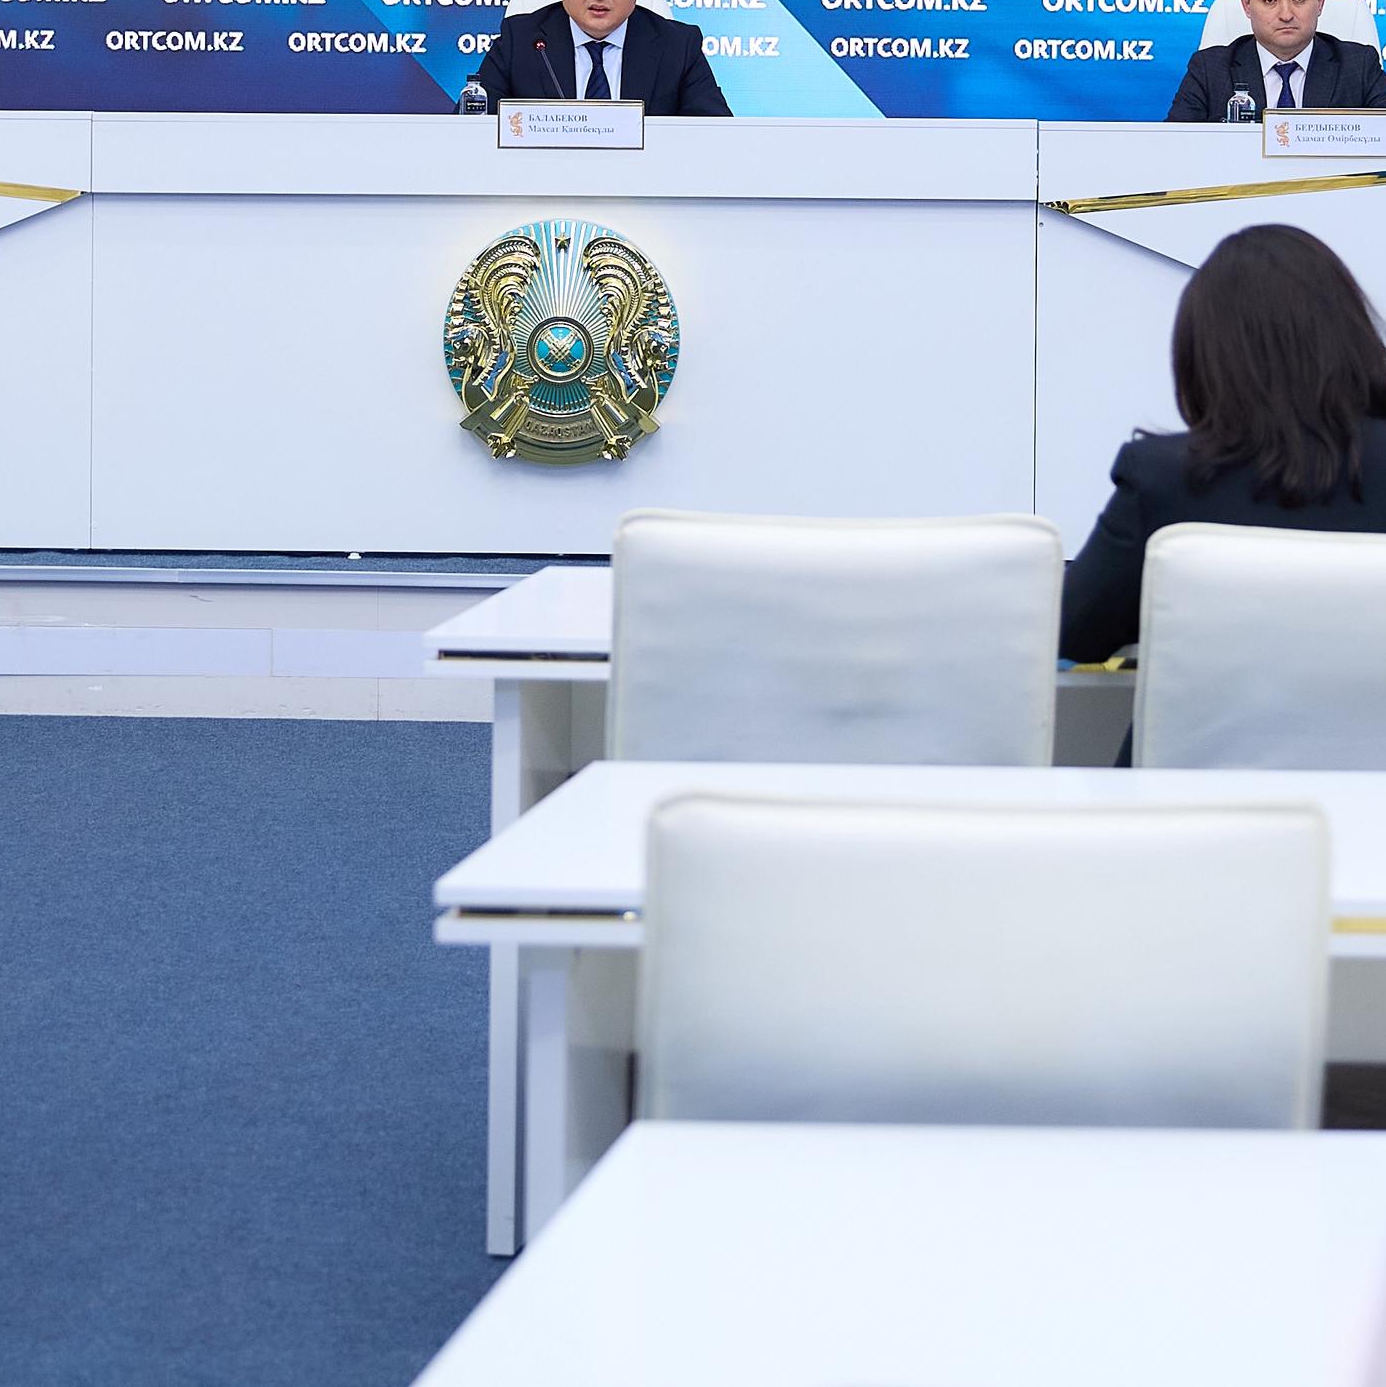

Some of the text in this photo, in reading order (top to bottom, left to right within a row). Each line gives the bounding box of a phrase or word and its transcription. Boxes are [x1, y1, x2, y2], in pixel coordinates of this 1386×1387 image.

[106, 31, 244, 52] ORTCOM.KZ
[288, 33, 427, 53] ORTCOM.KZ
[830, 38, 970, 59] ORTCOM.KZ
[1014, 39, 1154, 61] ORTCOM.KZ
[528, 113, 588, 122] БАЛАБЕКОВ
[1295, 124, 1361, 133] БЕРДЫБЕКОВ
